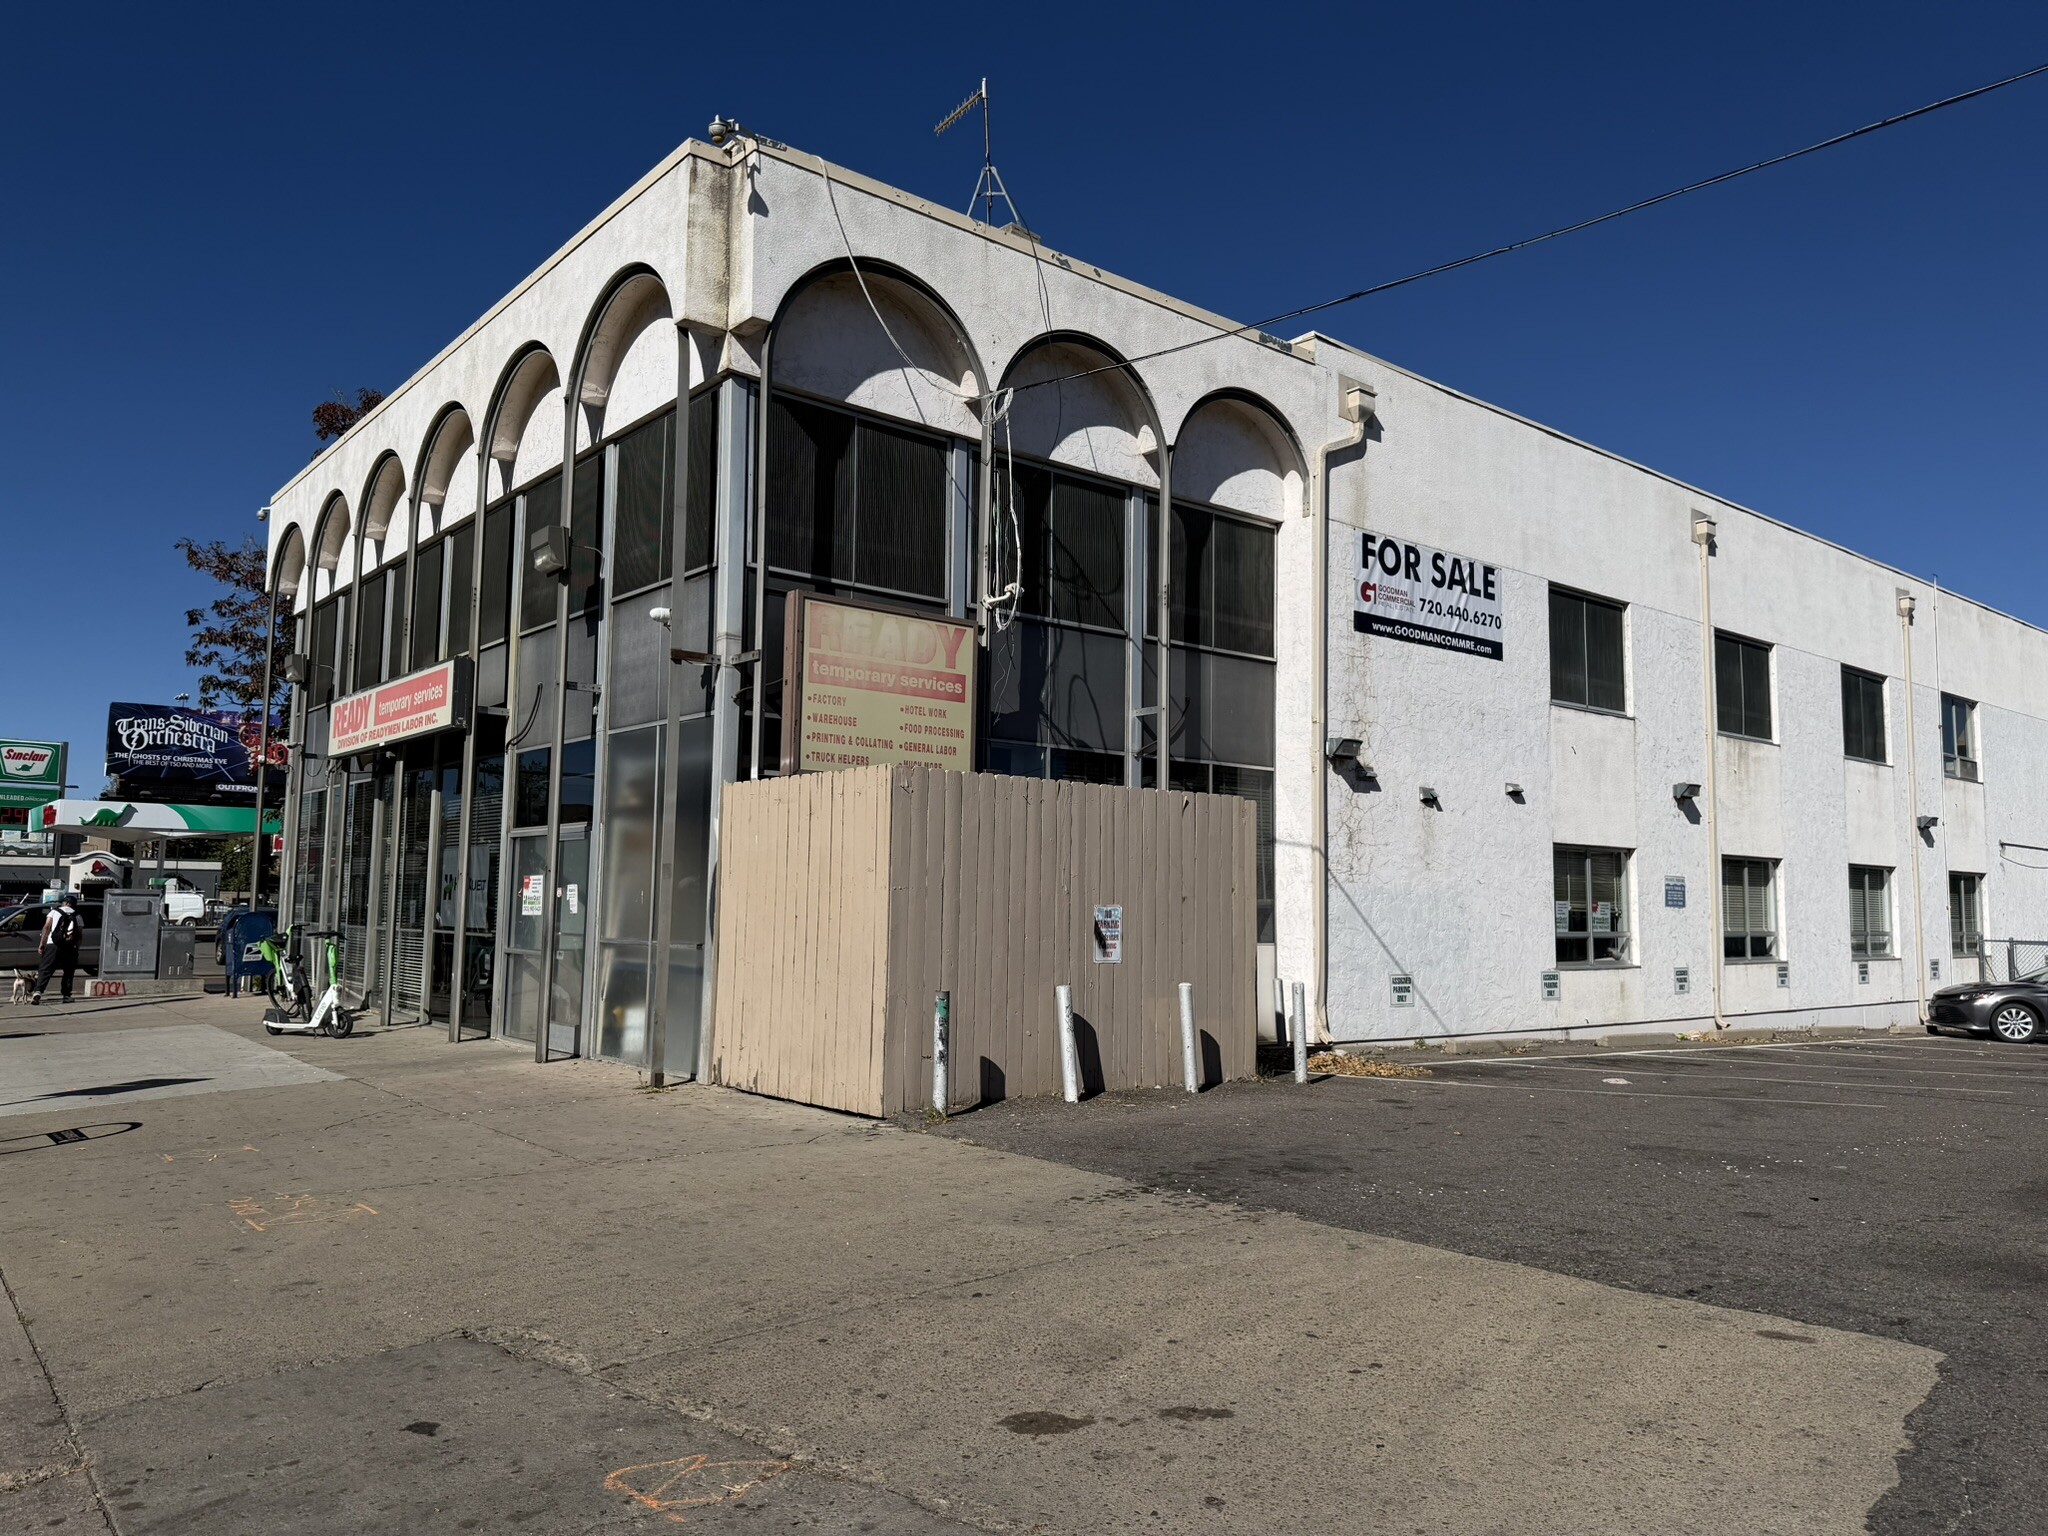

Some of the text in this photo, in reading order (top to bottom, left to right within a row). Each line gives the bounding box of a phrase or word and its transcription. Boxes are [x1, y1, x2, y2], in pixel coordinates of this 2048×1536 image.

[1362, 533, 1496, 601] FOR SALE
[1378, 584, 1408, 597] GOODMAN
[1378, 593, 1416, 607] COMMERCIAL
[1420, 598, 1502, 630] 720.440.6270
[809, 602, 967, 670] READY
[1372, 622, 1492, 654] www.GOODMANCOMMRE.com
[812, 660, 963, 694] temporary services
[812, 693, 847, 707] FACTORY
[333, 683, 443, 739] READY temporary services
[904, 705, 947, 719] HOTEL WORK
[812, 713, 857, 727] WAREHOUSE
[115, 715, 229, 744] Trans-Siberian
[338, 712, 438, 750] DIVISION OF READYMEN LABOR INC.
[904, 724, 965, 739] FOOD PROCESSING
[122, 727, 216, 754] Orchestra
[811, 732, 893, 749] PRINTING & COLLATING
[4, 748, 49, 762] Sinclair
[904, 742, 957, 756] GENERAL LABOR
[811, 751, 870, 766] TRUCK HELPERS
[217, 784, 259, 793] OUTFRON
[1097, 920, 1119, 929] PARKING
